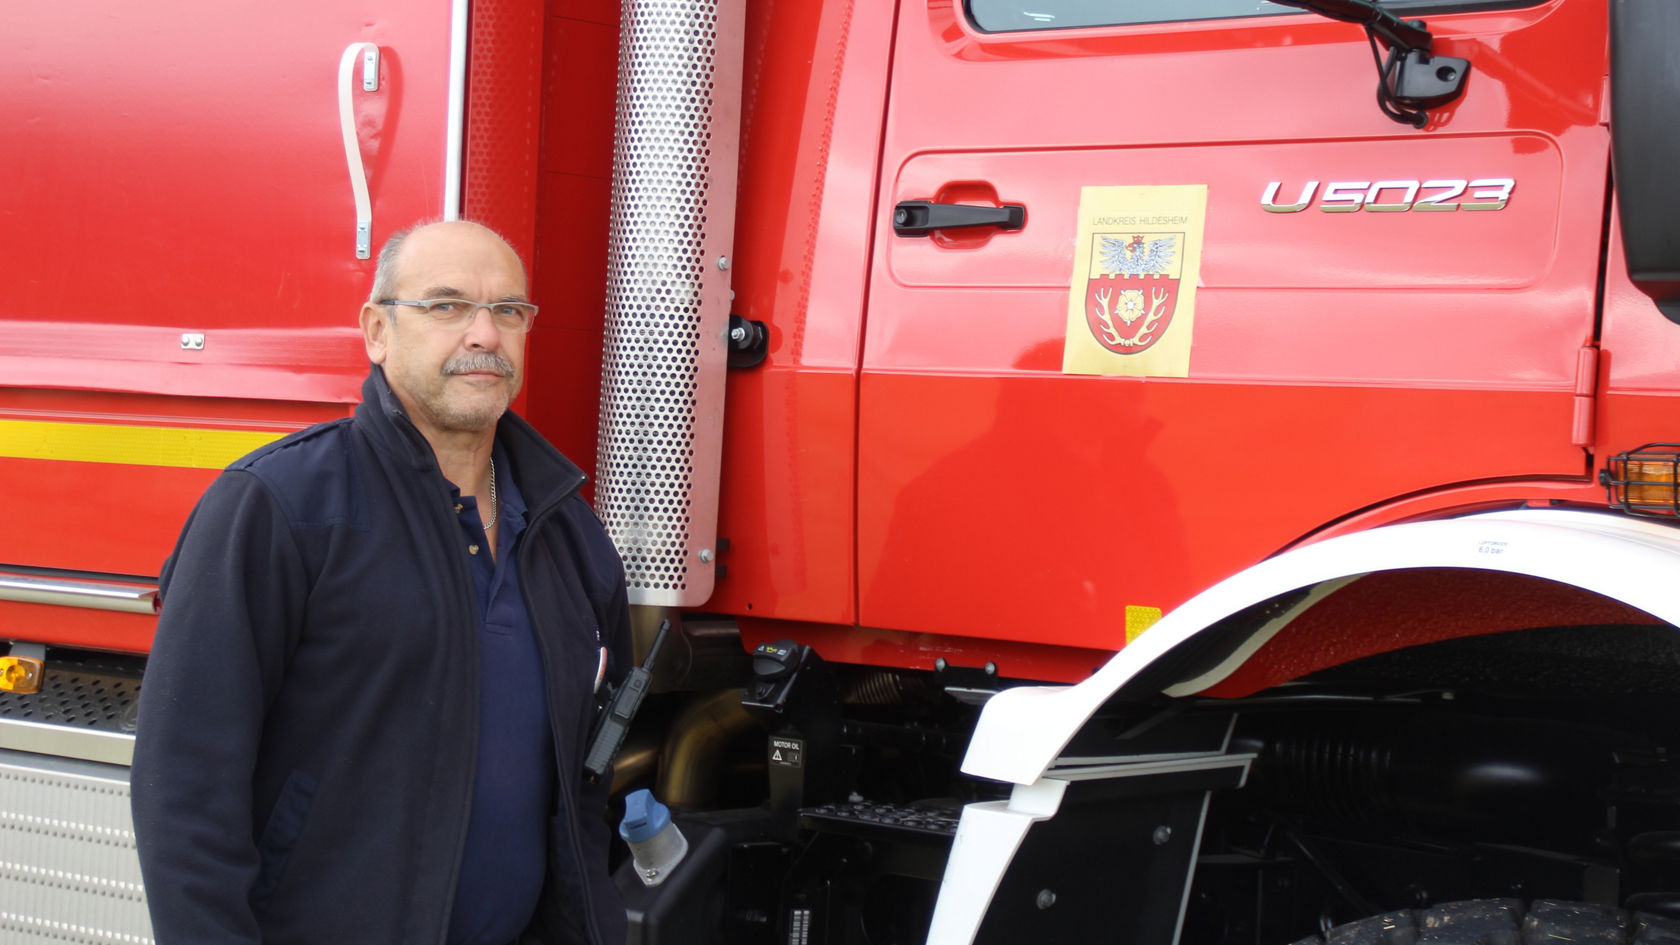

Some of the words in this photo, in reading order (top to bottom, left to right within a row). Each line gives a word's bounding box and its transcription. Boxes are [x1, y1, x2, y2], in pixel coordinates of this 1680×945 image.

[1092, 216, 1137, 226] LANDKREIS
[1138, 215, 1188, 225] HILDESHEIM
[773, 740, 791, 749] MOTOR
[791, 742, 800, 750] OIL
